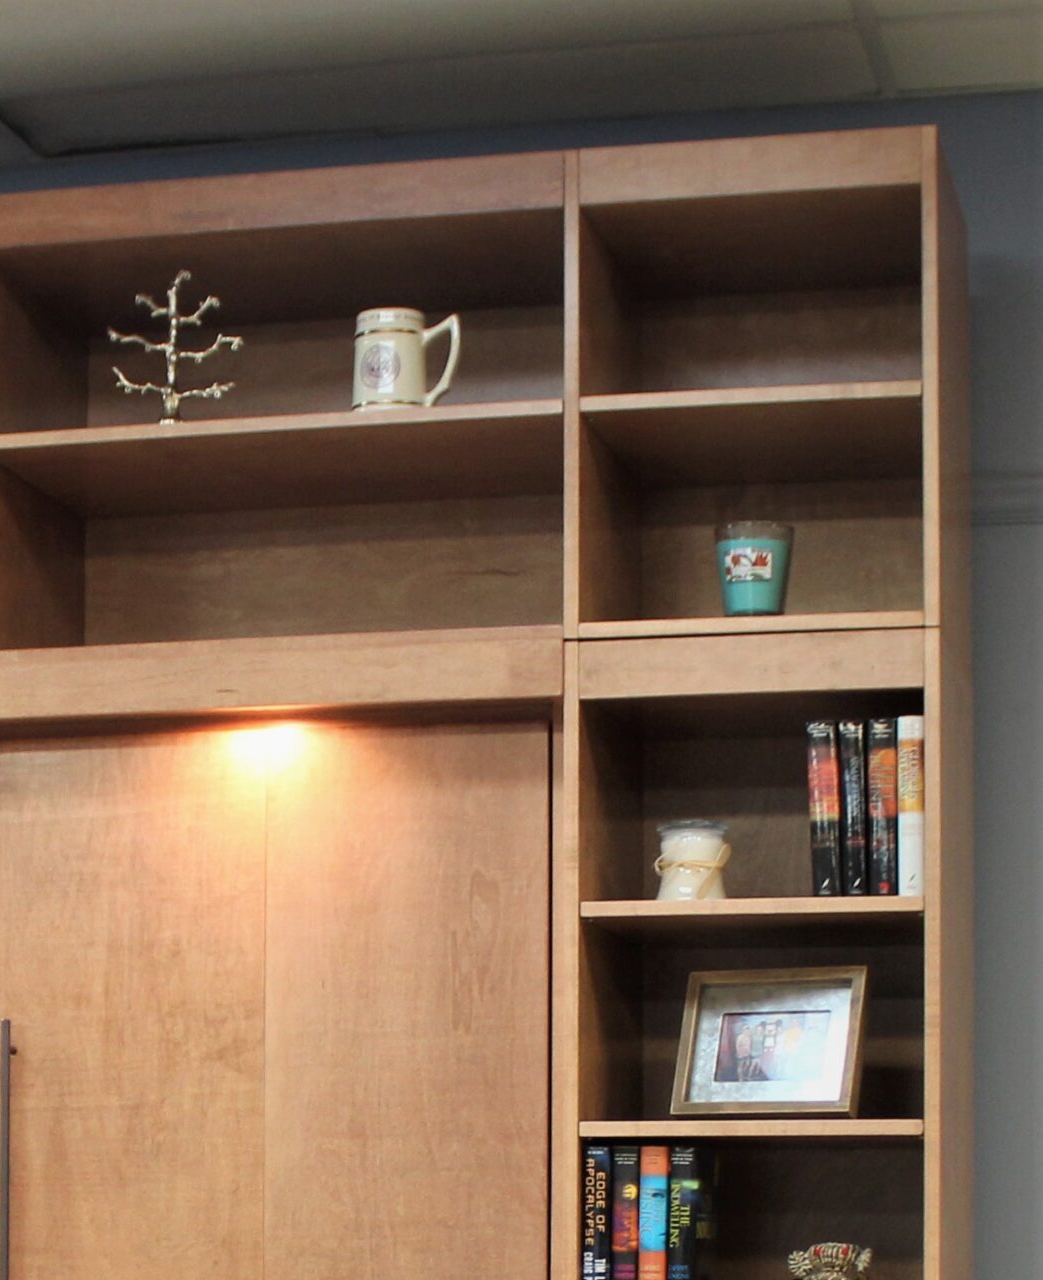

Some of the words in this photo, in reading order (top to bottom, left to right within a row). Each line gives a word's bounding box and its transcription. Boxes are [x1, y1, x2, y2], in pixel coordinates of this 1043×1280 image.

[595, 1171, 606, 1209] EDGE
[584, 1158, 595, 1246] APOCALYPSE
[595, 1214, 606, 1233] OF
[668, 1183, 680, 1248] INDWELLING
[680, 1204, 690, 1227] THE
[583, 1251, 594, 1274] CRAIG
[594, 1258, 606, 1273] TIM
